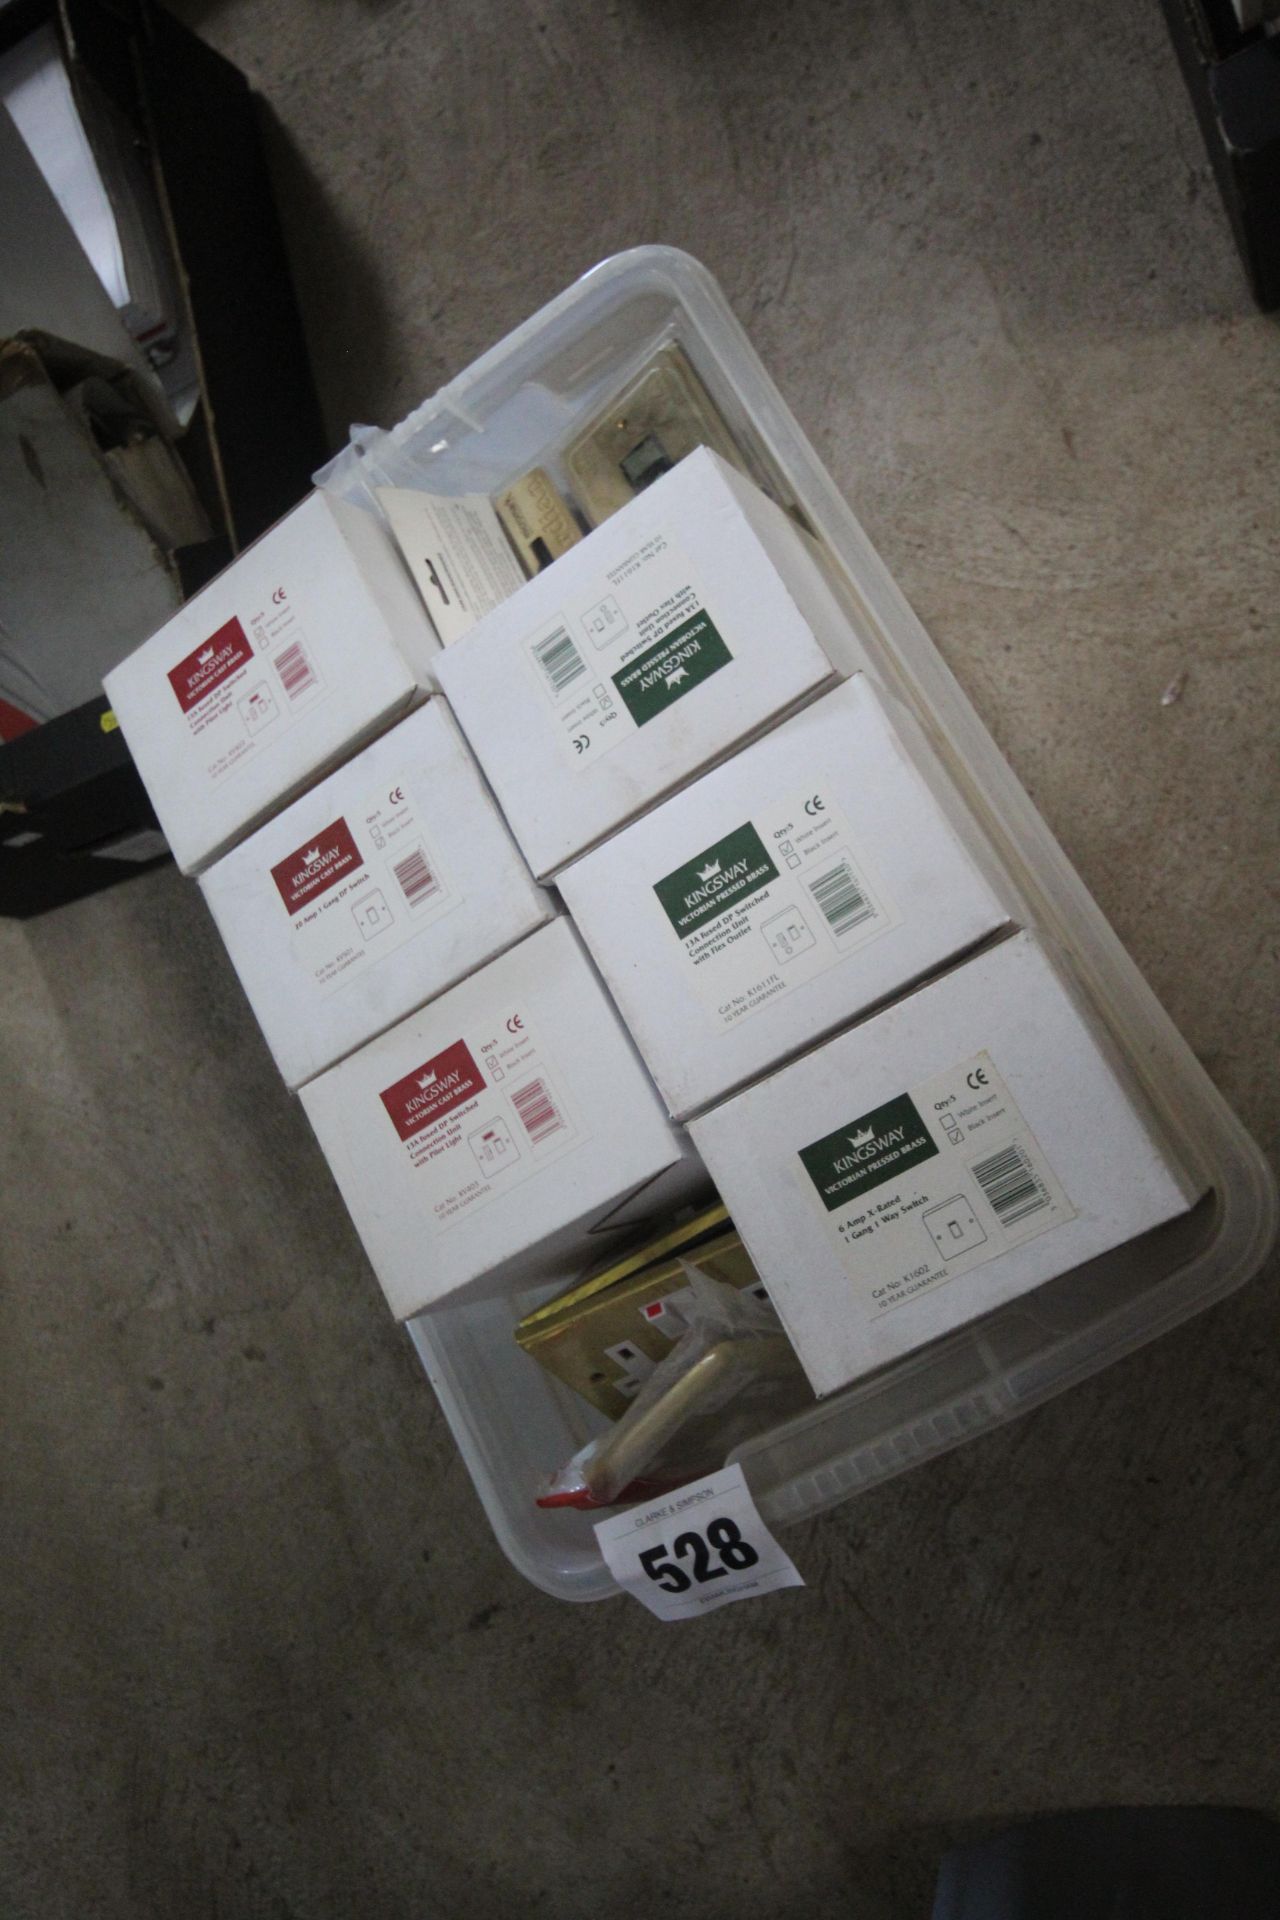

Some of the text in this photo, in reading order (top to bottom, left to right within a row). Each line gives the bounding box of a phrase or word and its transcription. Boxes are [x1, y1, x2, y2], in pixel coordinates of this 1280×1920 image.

[636, 585, 691, 627] with Flex Outlet
[638, 592, 695, 636] Connection Unit
[684, 600, 699, 612] 13A
[620, 635, 651, 661] Switched
[653, 626, 663, 637] DP
[187, 645, 232, 686] KINGSWAY
[620, 622, 706, 686] VICTORIAN PRESSED BRASS
[640, 640, 700, 690] KINGSWAY
[187, 651, 242, 698] VICTORIAN CAST BRASS
[804, 795, 824, 815] CE
[795, 818, 831, 843] White Insert
[803, 831, 838, 855] Black Insert
[291, 854, 351, 900] VICTORIAN CAST BRASS
[292, 846, 339, 886] KINGSWAY
[684, 859, 747, 907] KINGSWAY
[322, 896, 339, 908] Gang
[348, 873, 369, 889] Switch
[678, 864, 768, 925] VICTORIAN PRESSED BRASS
[685, 936, 699, 948] 13A
[721, 913, 732, 924] DP
[734, 890, 769, 915] Switched
[688, 916, 748, 957] Connection Unit
[693, 925, 751, 965] with Flex Outlet
[718, 1003, 731, 1014] Cat
[732, 1004, 748, 1016] YEAR
[748, 981, 786, 1007] GUARANTEE
[405, 1070, 459, 1112] KINGSWAY
[966, 1068, 988, 1089] CE
[405, 1079, 472, 1125] VICTORIAN CAST BRASS
[958, 1093, 996, 1117] White Insert
[967, 1108, 1005, 1131] Black Insert
[406, 1139, 419, 1150] 13A
[438, 1119, 447, 1129] DP
[448, 1100, 478, 1122] Switched
[409, 1124, 461, 1159] Connection Unit
[413, 1134, 461, 1167] with Pilot Light
[824, 1136, 926, 1193] VICTORIAN PRESSED BRASS
[833, 1126, 903, 1172] KINGSWAY
[846, 1215, 865, 1228] Amp
[866, 1195, 900, 1216] X-Rated
[851, 1225, 873, 1239] Gang
[880, 1212, 899, 1222] Way
[900, 1195, 928, 1213] Switch
[871, 1287, 886, 1298] Cat
[902, 1264, 929, 1282] K1602
[887, 1290, 906, 1302] YEAR
[906, 1269, 948, 1293] GUARANTEE
[634, 1487, 714, 1528] CLARKE & SIMPSON
[638, 1517, 759, 1593] 528
